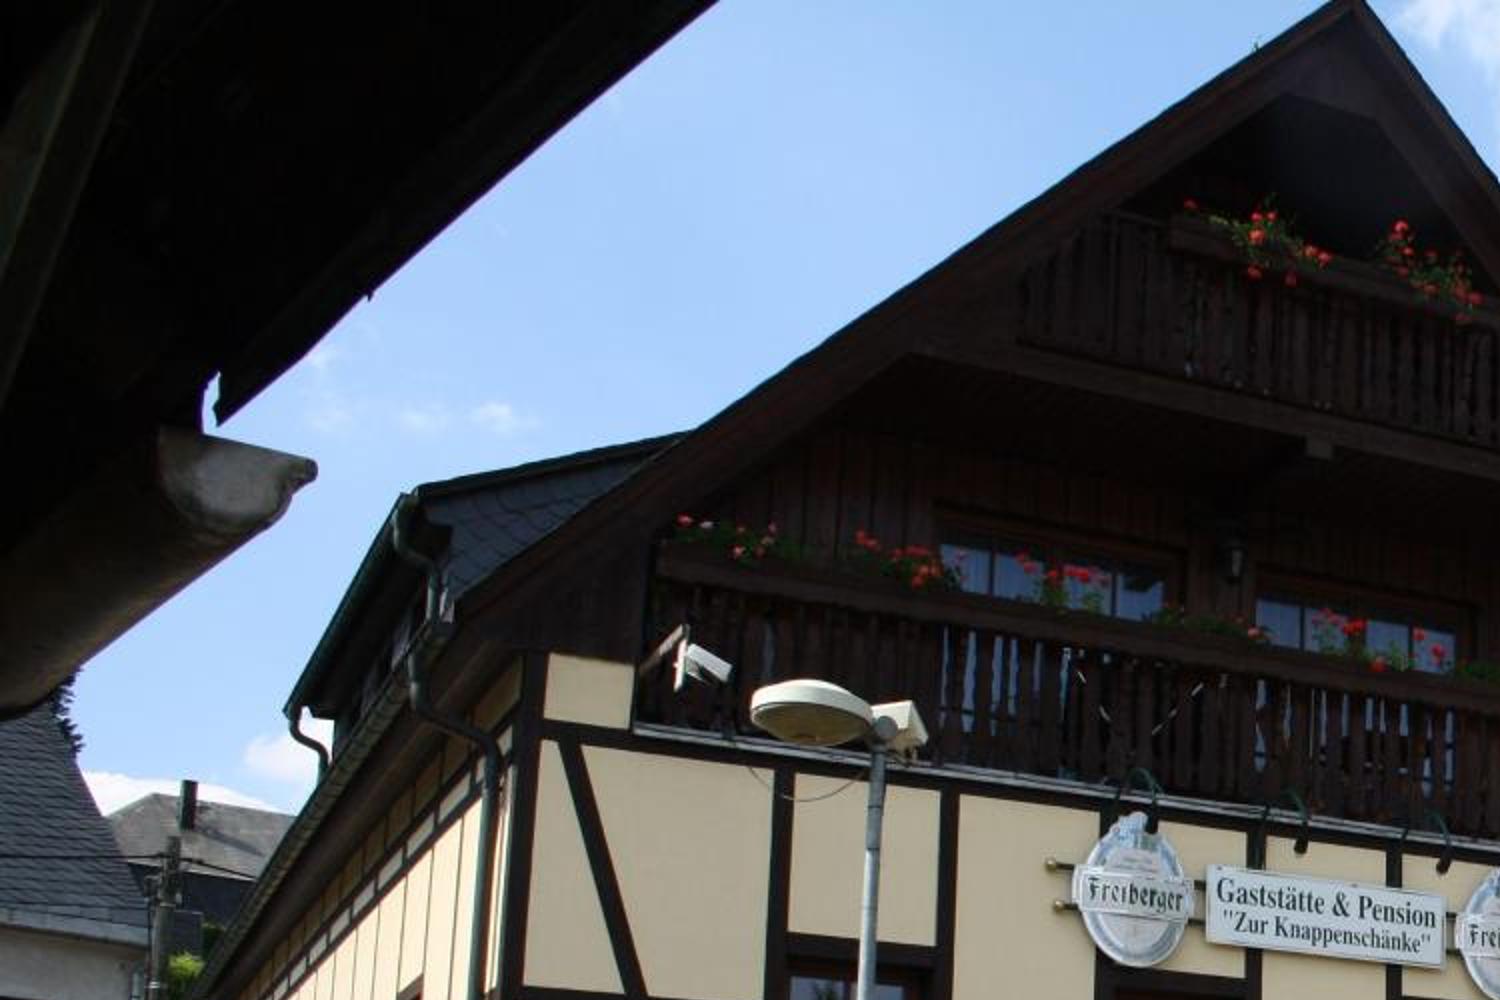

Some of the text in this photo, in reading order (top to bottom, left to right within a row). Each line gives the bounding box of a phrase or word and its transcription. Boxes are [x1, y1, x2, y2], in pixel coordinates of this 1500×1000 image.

[1087, 876, 1184, 913] Freiberger
[1216, 877, 1436, 928] Gaststätte & Pension
